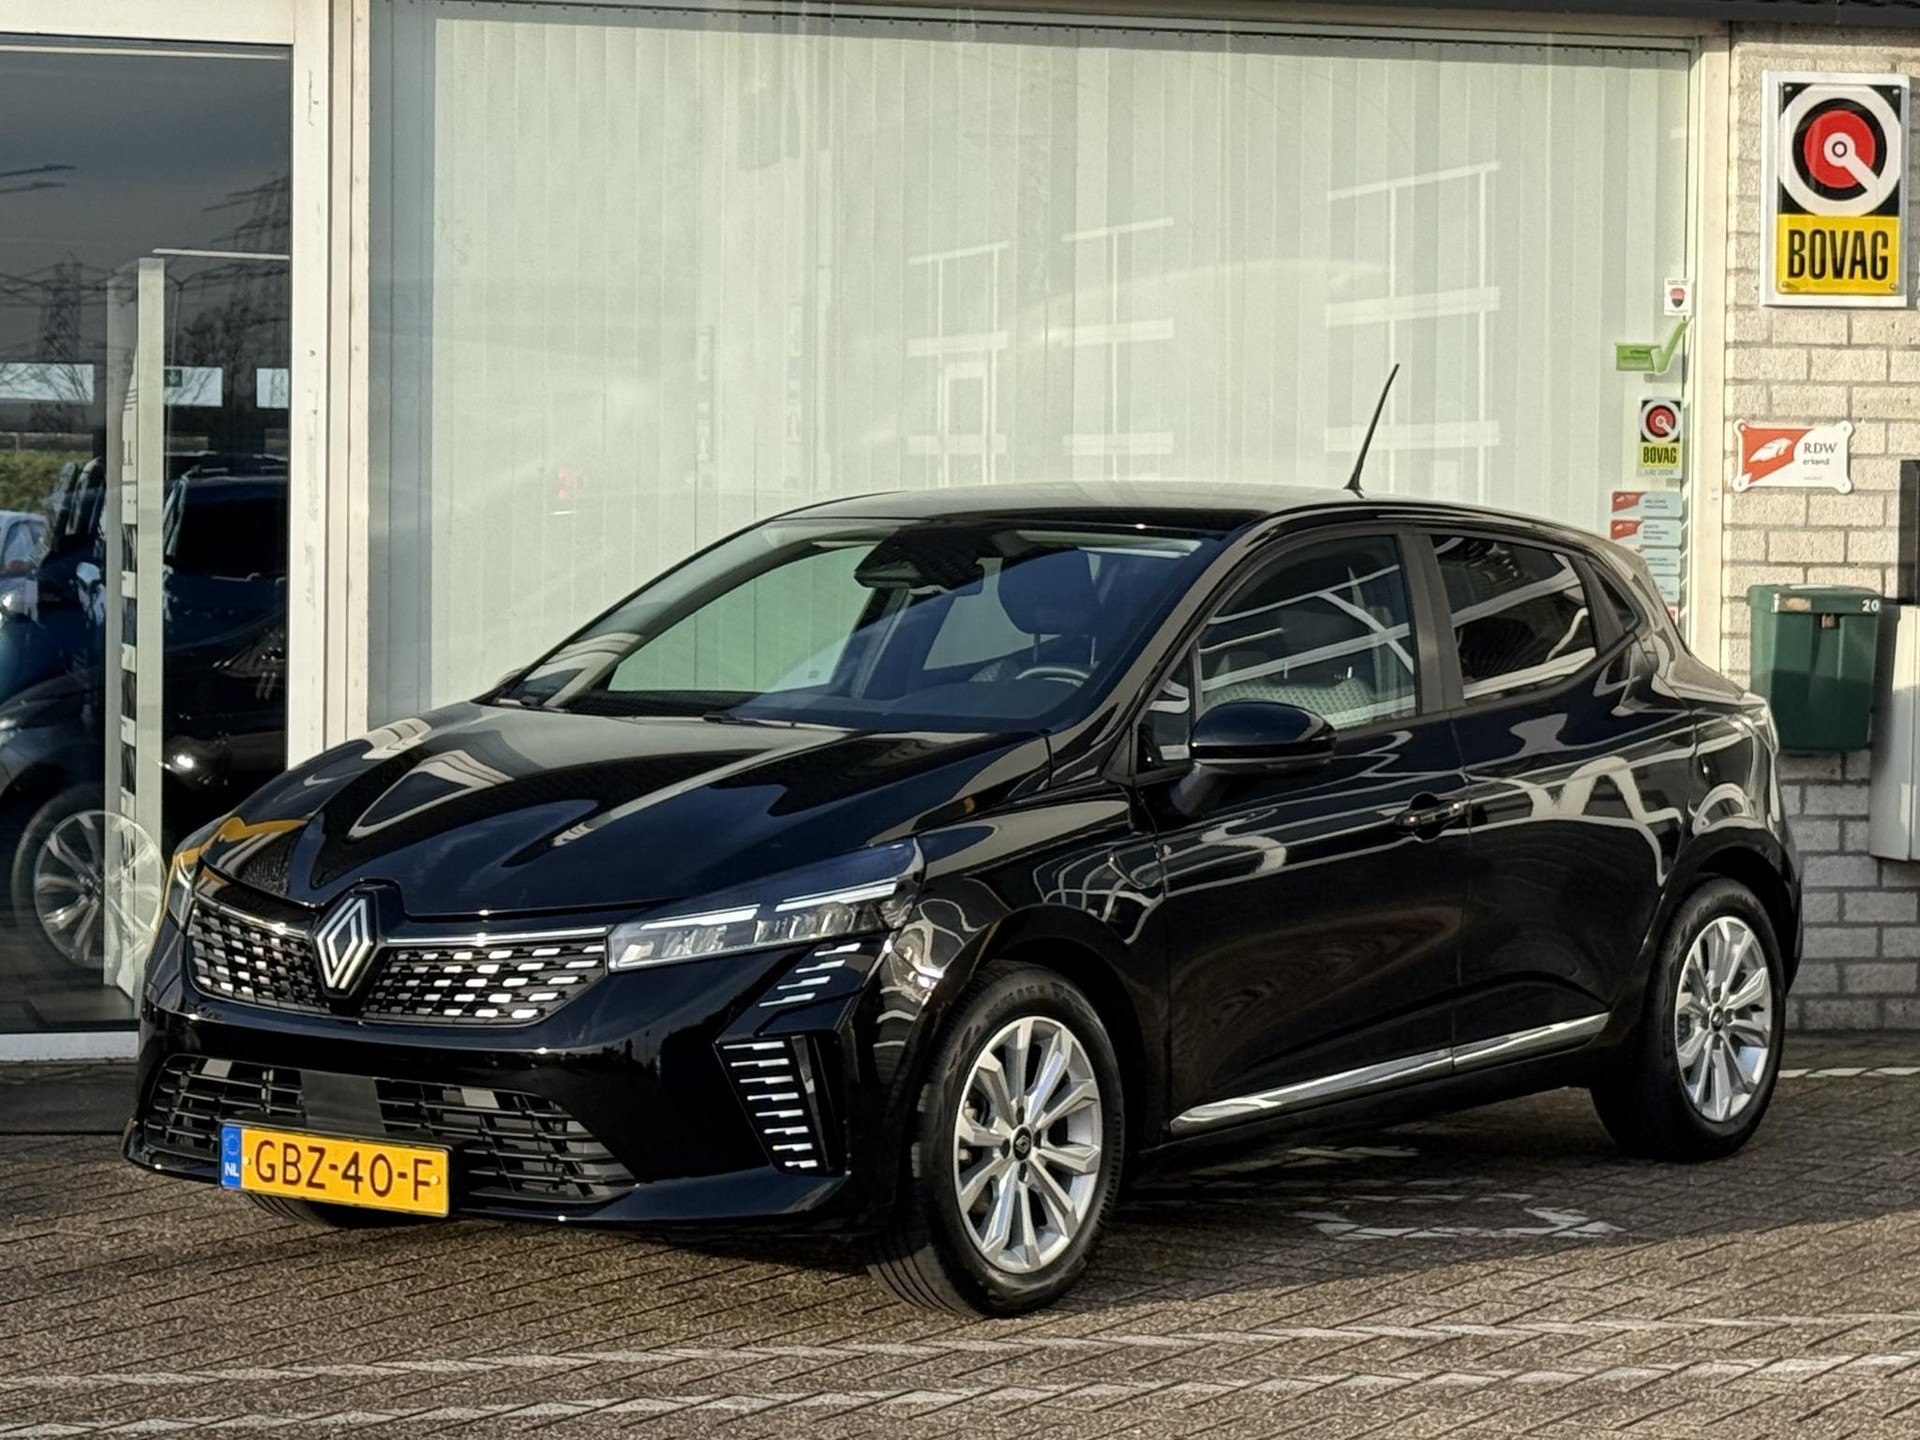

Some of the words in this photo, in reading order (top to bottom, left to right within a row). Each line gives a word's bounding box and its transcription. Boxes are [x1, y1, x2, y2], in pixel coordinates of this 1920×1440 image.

[1787, 228, 1889, 281] BOVAG
[1642, 446, 1677, 465] BOVAG
[1803, 442, 1838, 454] RDW
[1862, 599, 1880, 612] 20
[224, 1162, 240, 1178] NL
[255, 1139, 434, 1202] GBZ-40-F
